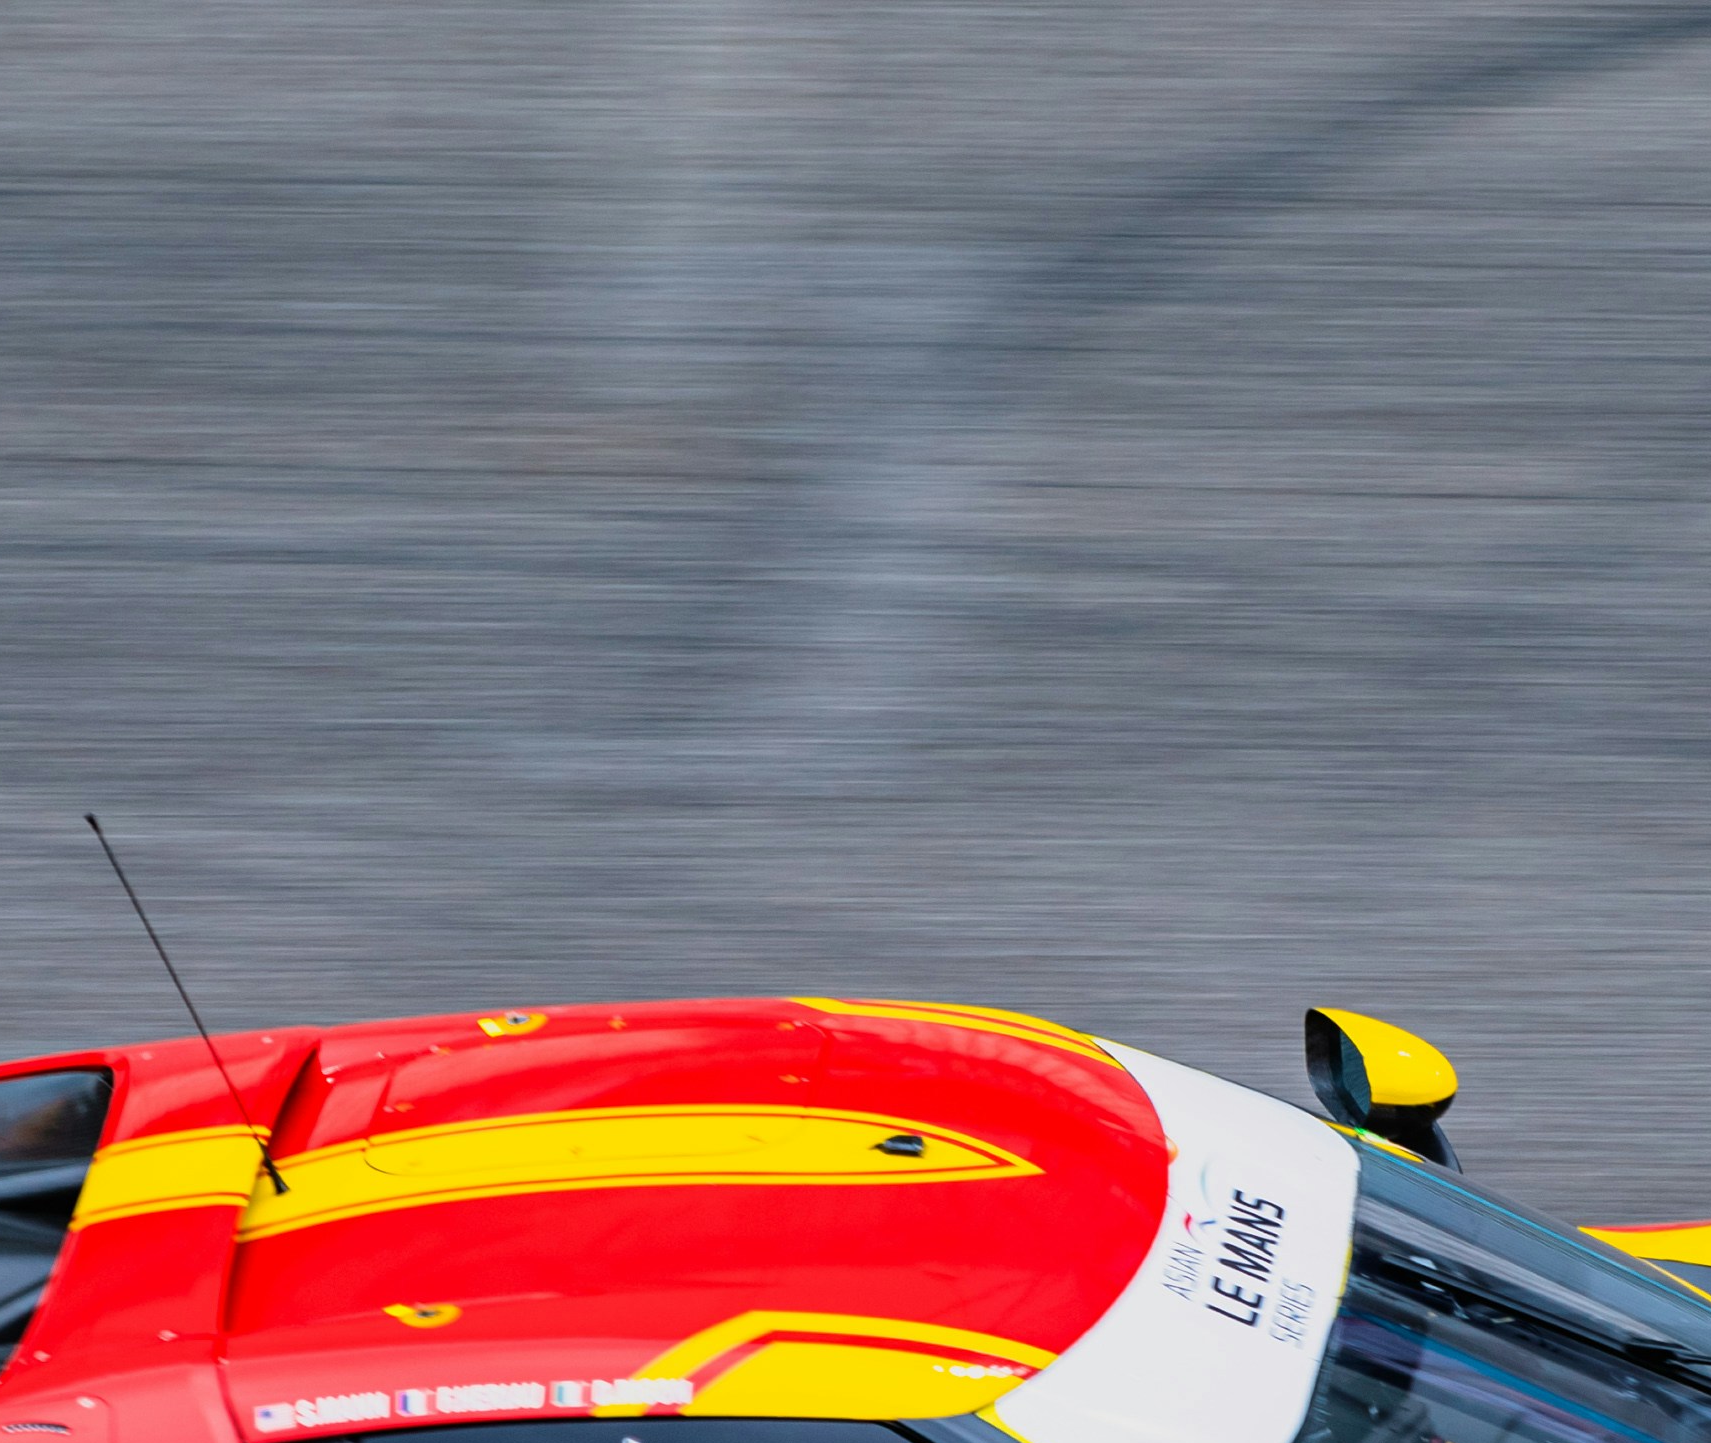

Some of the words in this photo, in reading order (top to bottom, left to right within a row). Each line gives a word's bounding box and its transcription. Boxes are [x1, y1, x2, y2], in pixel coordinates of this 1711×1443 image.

[1220, 1188, 1288, 1284] MANS
[1162, 1240, 1203, 1300] ASIAN
[1206, 1276, 1265, 1328] LE
[1270, 1278, 1316, 1349] SERIES
